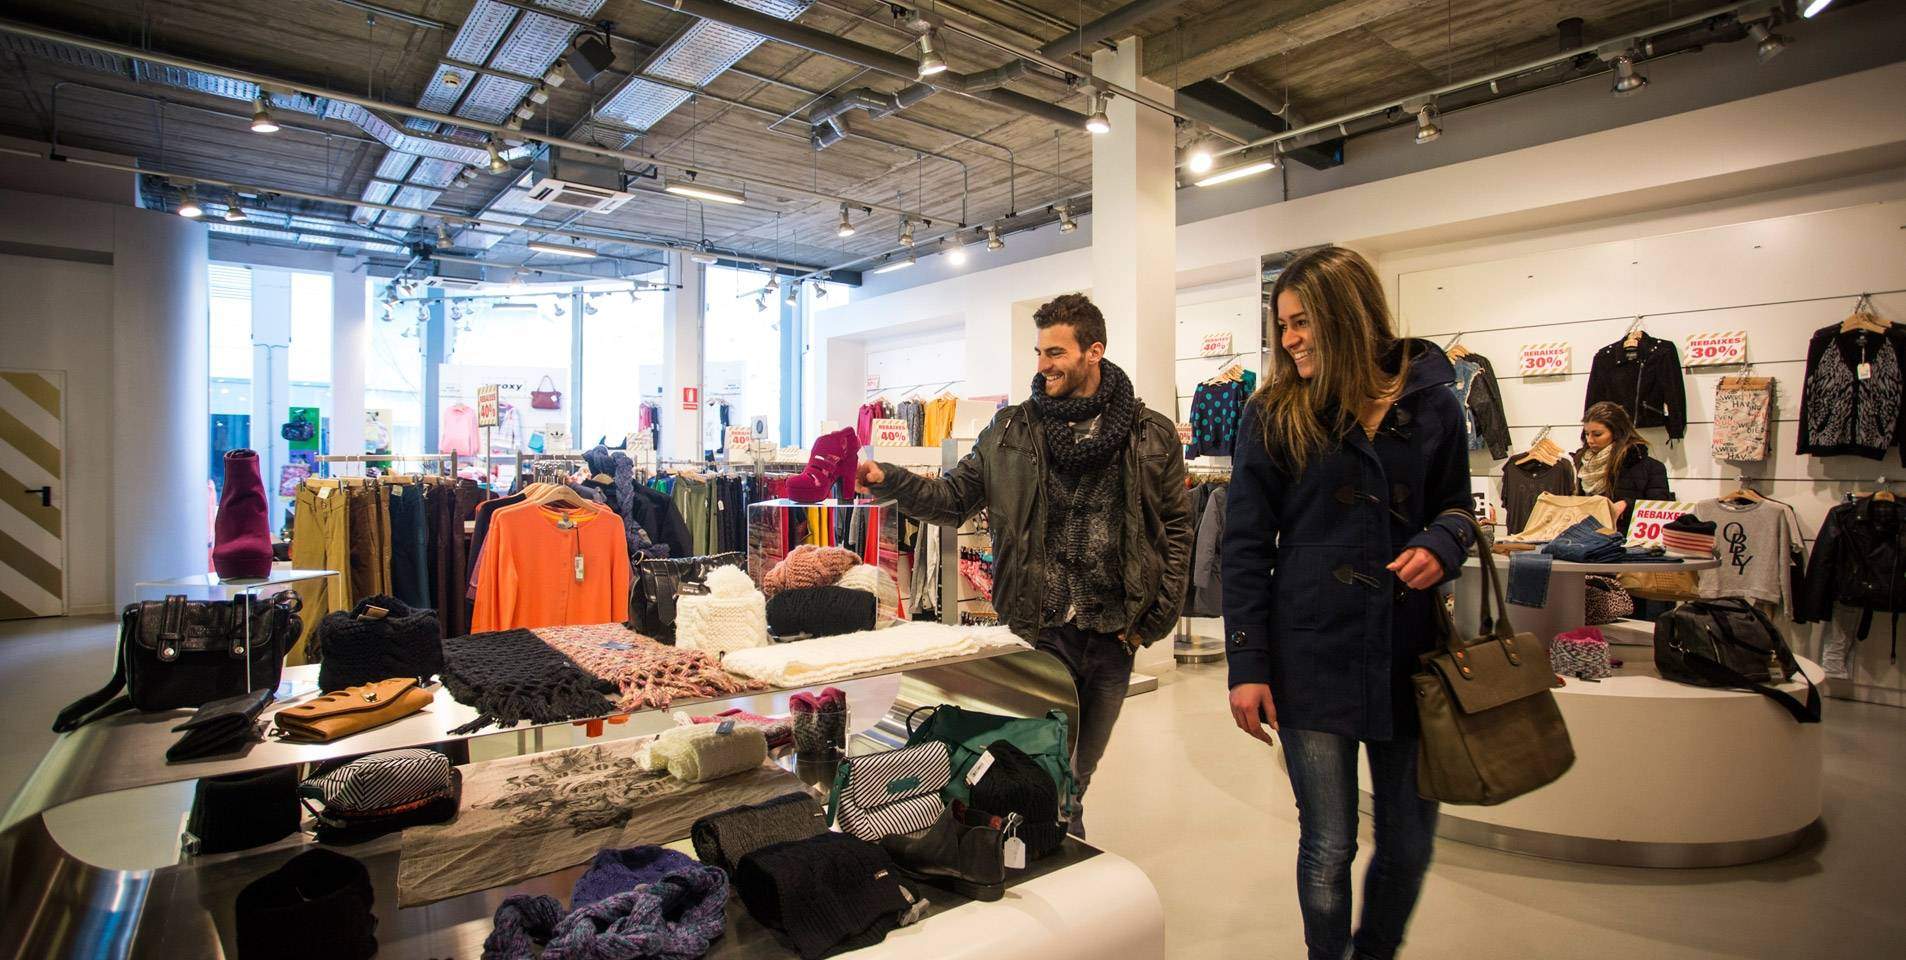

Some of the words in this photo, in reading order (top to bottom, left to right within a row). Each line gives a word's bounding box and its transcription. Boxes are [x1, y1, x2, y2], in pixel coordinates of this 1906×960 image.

[1691, 337, 1741, 346] REBAIXES
[1691, 345, 1738, 358] 30%
[1525, 356, 1562, 368] 30%
[881, 431, 906, 441] 40%
[1634, 522, 1663, 540] 30
[1723, 521, 1754, 575] OBEY
